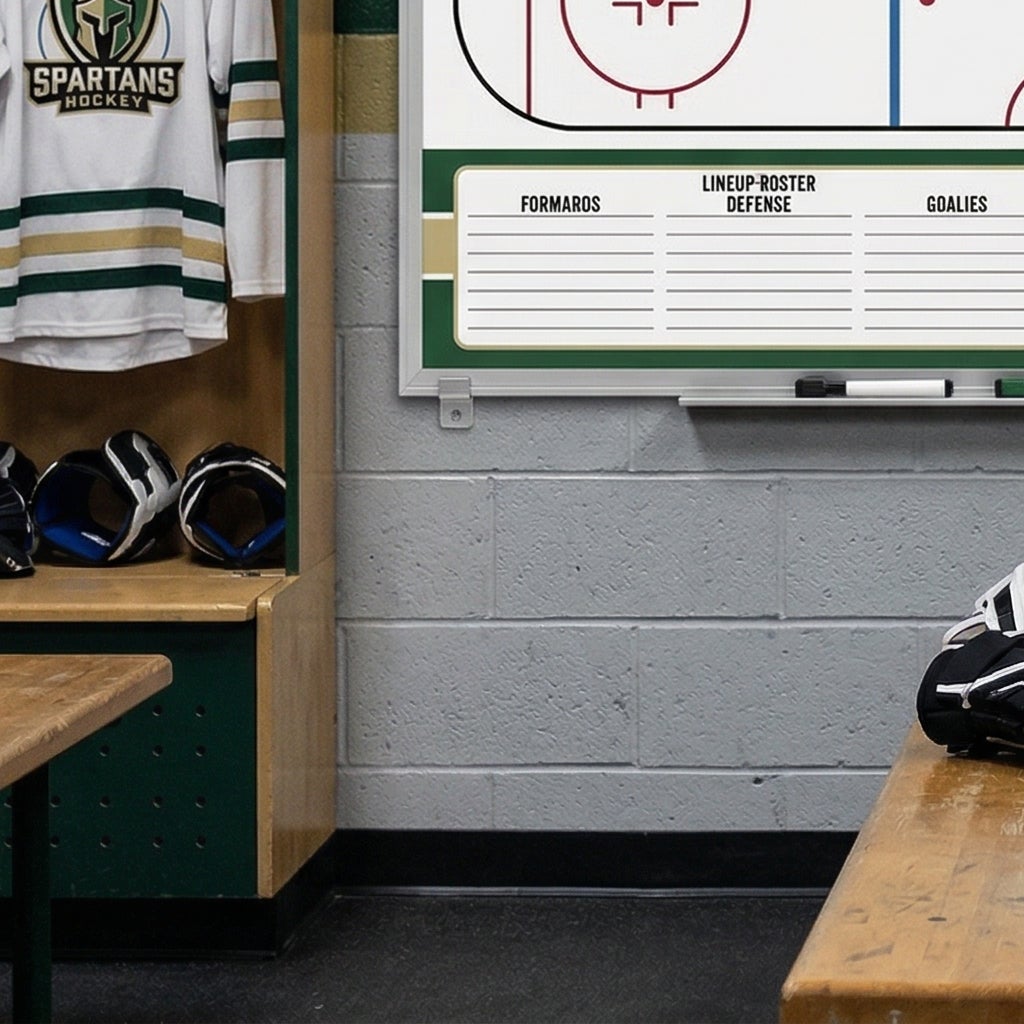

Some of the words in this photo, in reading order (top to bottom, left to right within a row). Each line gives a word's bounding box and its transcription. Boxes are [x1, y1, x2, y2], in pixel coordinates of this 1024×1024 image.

[33, 66, 175, 97] SPARTANS
[65, 93, 143, 108] HOCKEY
[521, 195, 601, 213] FORMAROS
[727, 195, 792, 213] DEFENSE
[926, 195, 988, 213] GOALIES
